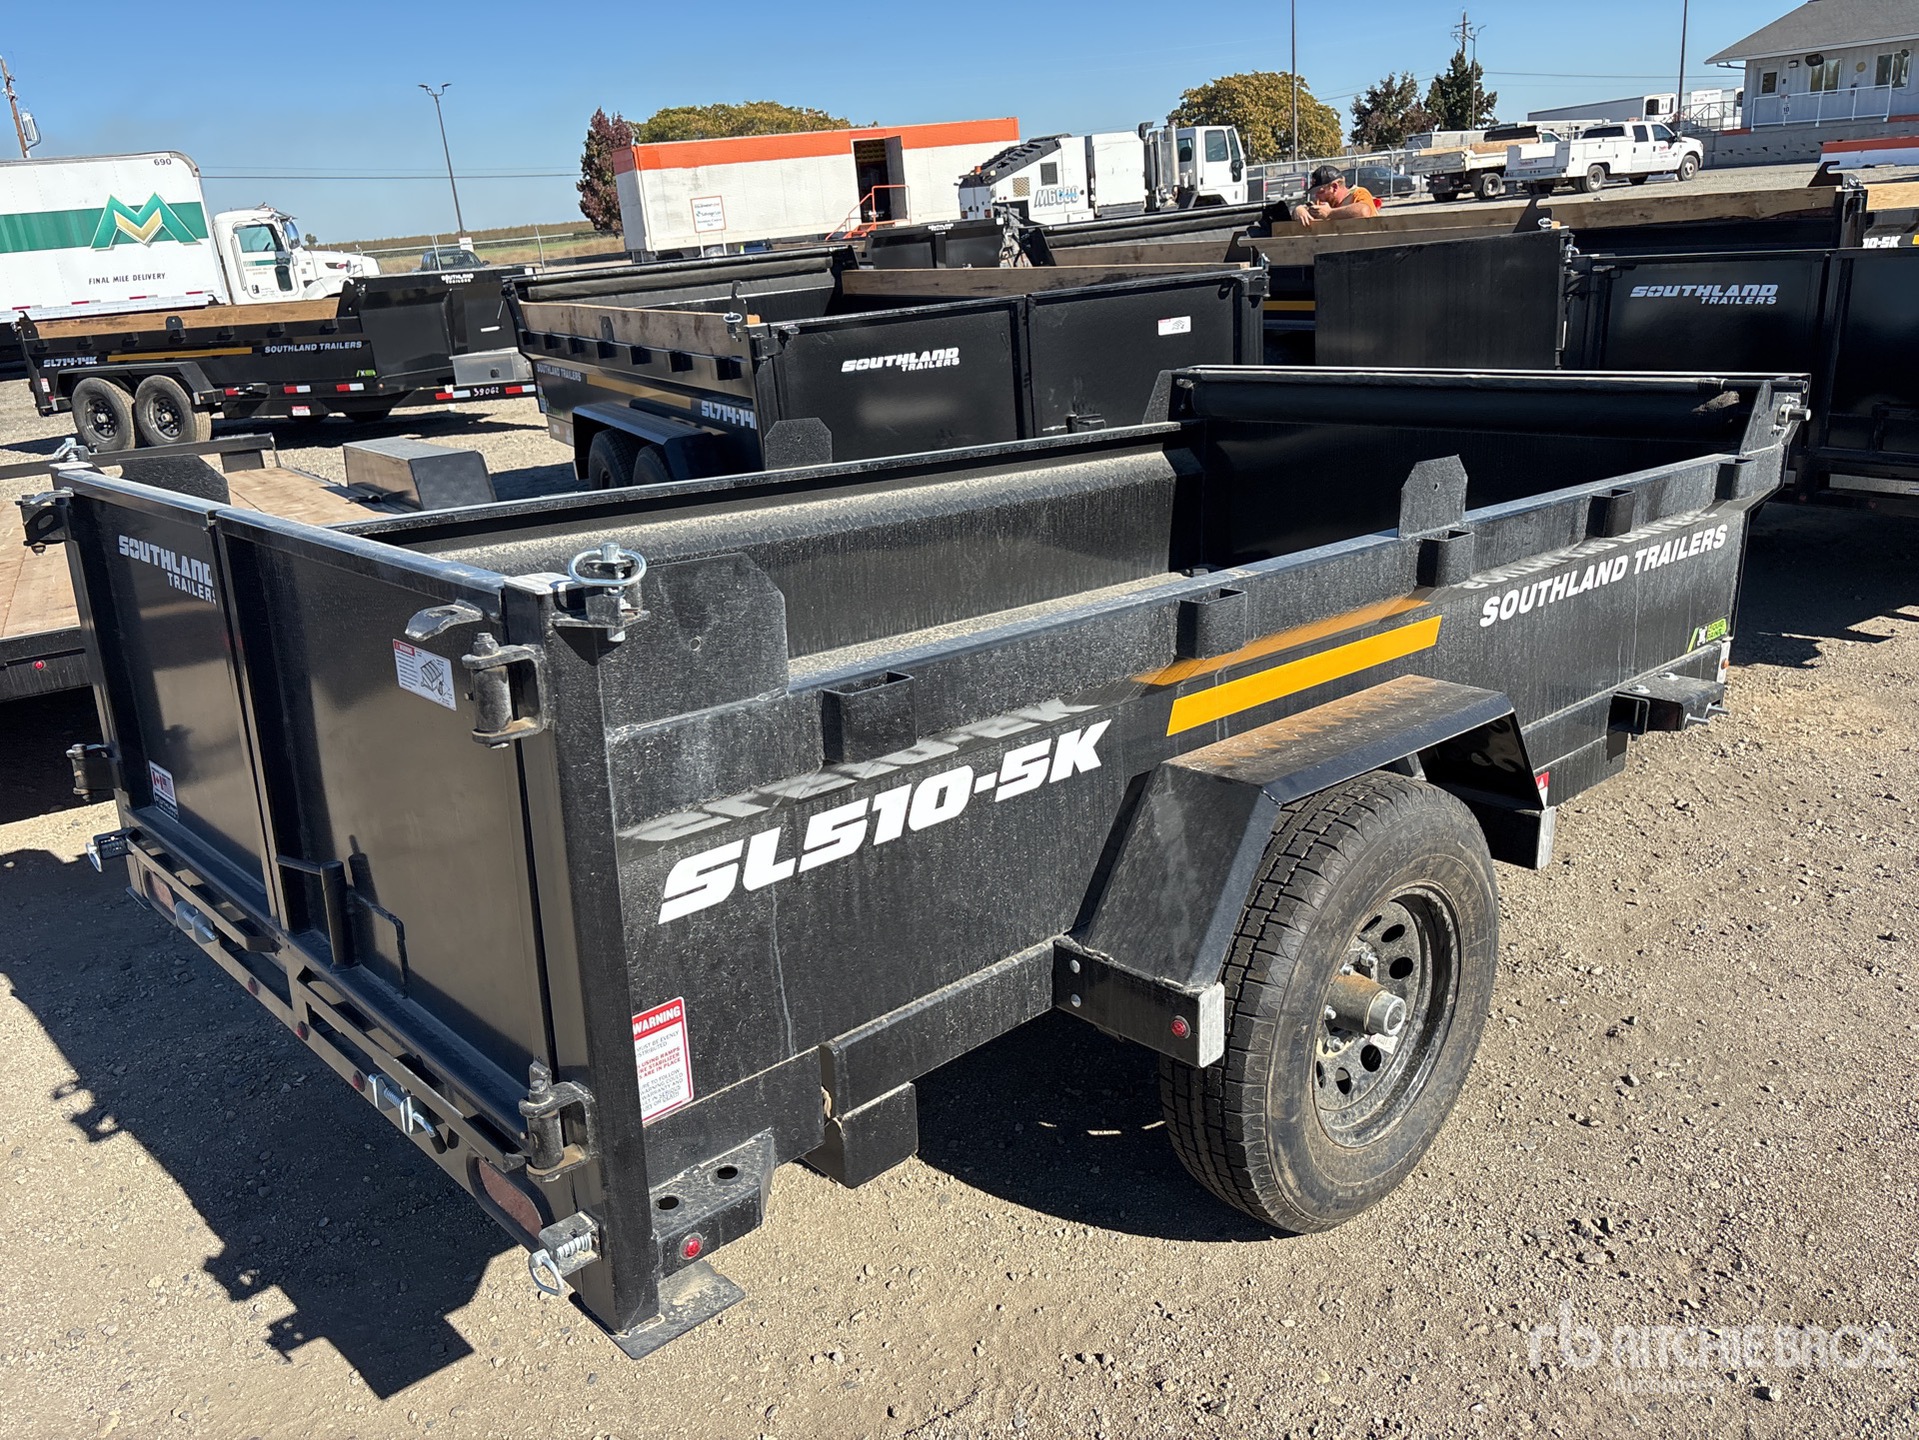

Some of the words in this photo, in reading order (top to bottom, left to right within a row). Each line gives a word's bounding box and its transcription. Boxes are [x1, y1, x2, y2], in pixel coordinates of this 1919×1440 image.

[88, 276, 110, 285] FINAL
[113, 275, 129, 283] MILE
[133, 272, 165, 281] DELIVERY
[1630, 284, 1779, 298] SOUTHLAND
[1701, 296, 1777, 305] TRAILERS
[265, 343, 317, 353] SOUTHLAND
[320, 341, 362, 350] TRAILERS
[44, 356, 98, 368] SL714-14K
[841, 347, 959, 372] SOUTHLAND
[901, 357, 960, 372] TRAILERS
[537, 364, 560, 376] SOUTHLAND
[561, 368, 581, 382] TRAILERS
[119, 534, 213, 587] SOUTHLAND
[1479, 554, 1628, 628] SOUTHLAND
[1634, 524, 1728, 575] TRAILERS
[658, 718, 1112, 925] SL510-5K
[633, 1006, 681, 1035] WARNING
[660, 1046, 680, 1058] RAMPS
[663, 1057, 680, 1068] PLACE
